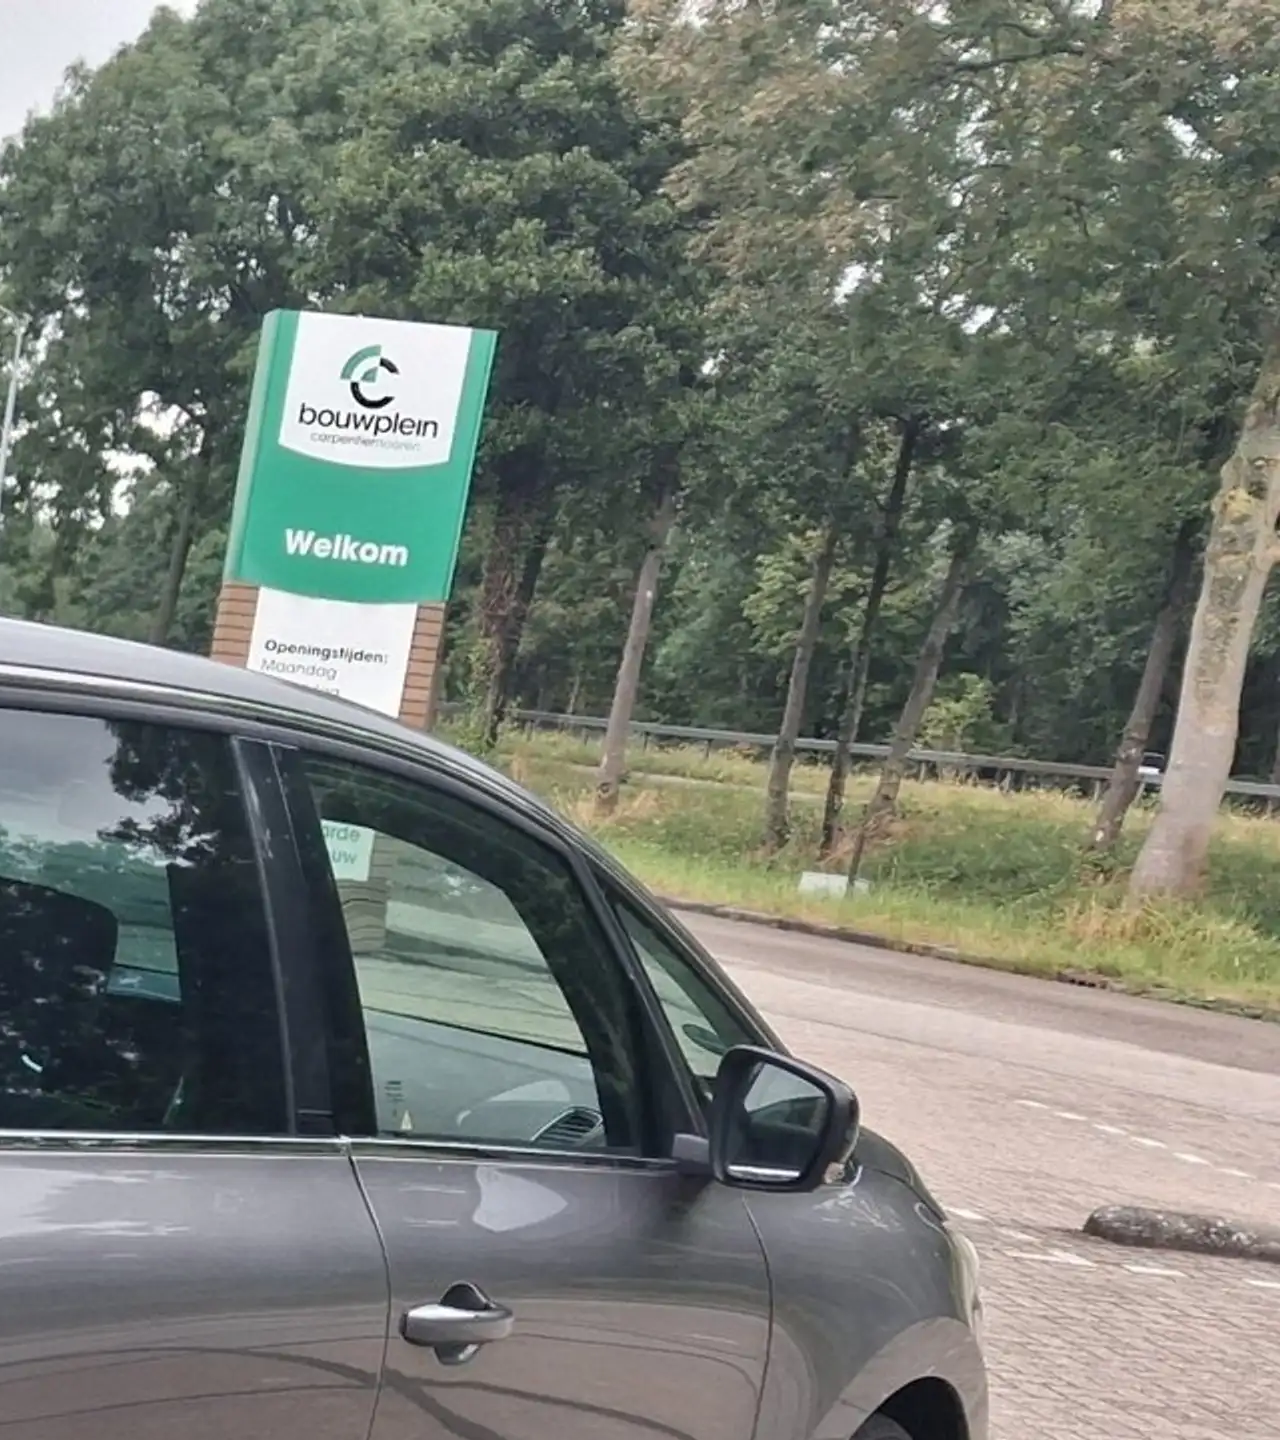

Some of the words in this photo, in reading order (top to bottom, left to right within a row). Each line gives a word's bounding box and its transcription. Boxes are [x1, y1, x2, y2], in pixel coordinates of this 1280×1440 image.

[298, 402, 439, 439] bouwplein
[284, 528, 409, 567] Welkom
[264, 639, 389, 665] Openingstijden:
[259, 658, 338, 681] Maandag
